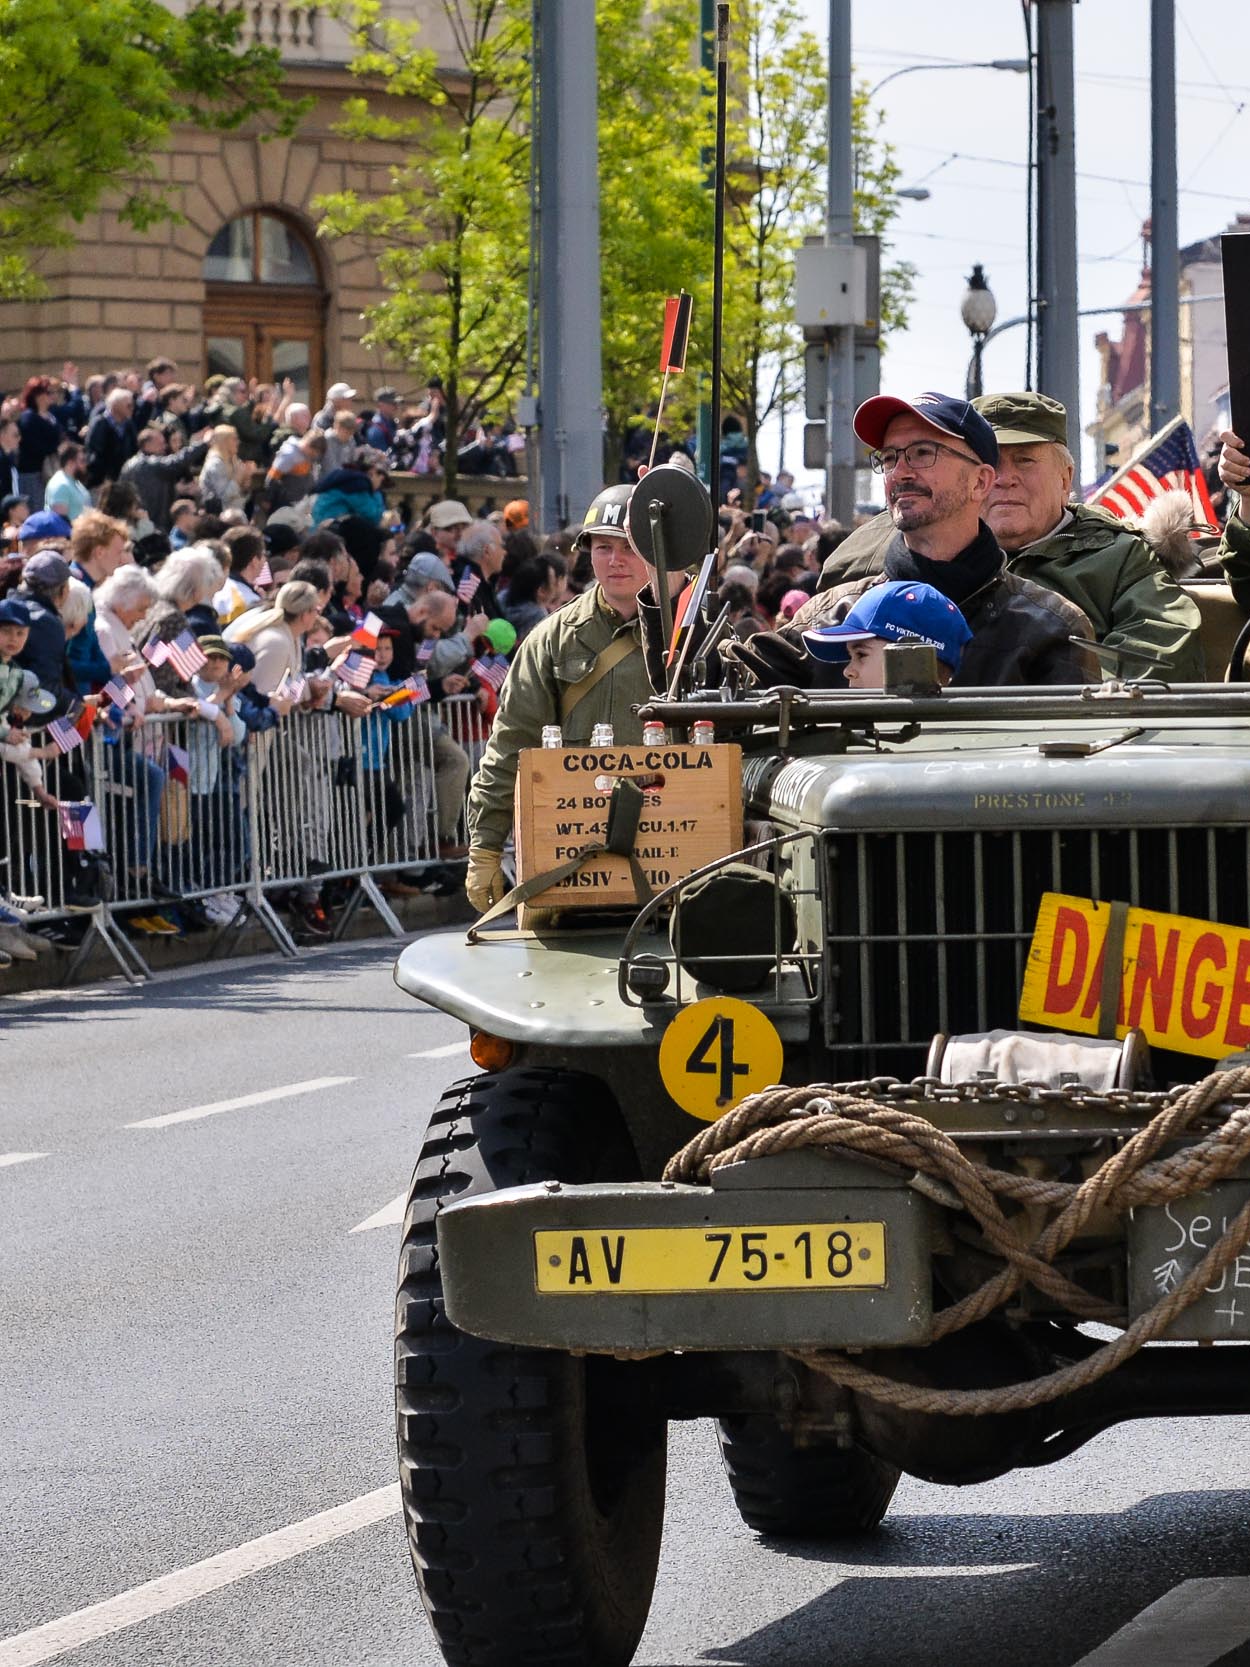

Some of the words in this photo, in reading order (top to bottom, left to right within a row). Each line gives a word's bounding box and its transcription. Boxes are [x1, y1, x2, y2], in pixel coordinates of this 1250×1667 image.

[602, 503, 622, 525] M
[885, 622, 896, 631] FC
[563, 751, 713, 772] COCA-COLA
[556, 797, 577, 810] 24
[974, 792, 1086, 808] PRESTONE
[685, 1016, 750, 1100] 4
[568, 1235, 625, 1285] AV
[705, 1230, 853, 1284] 75-18
